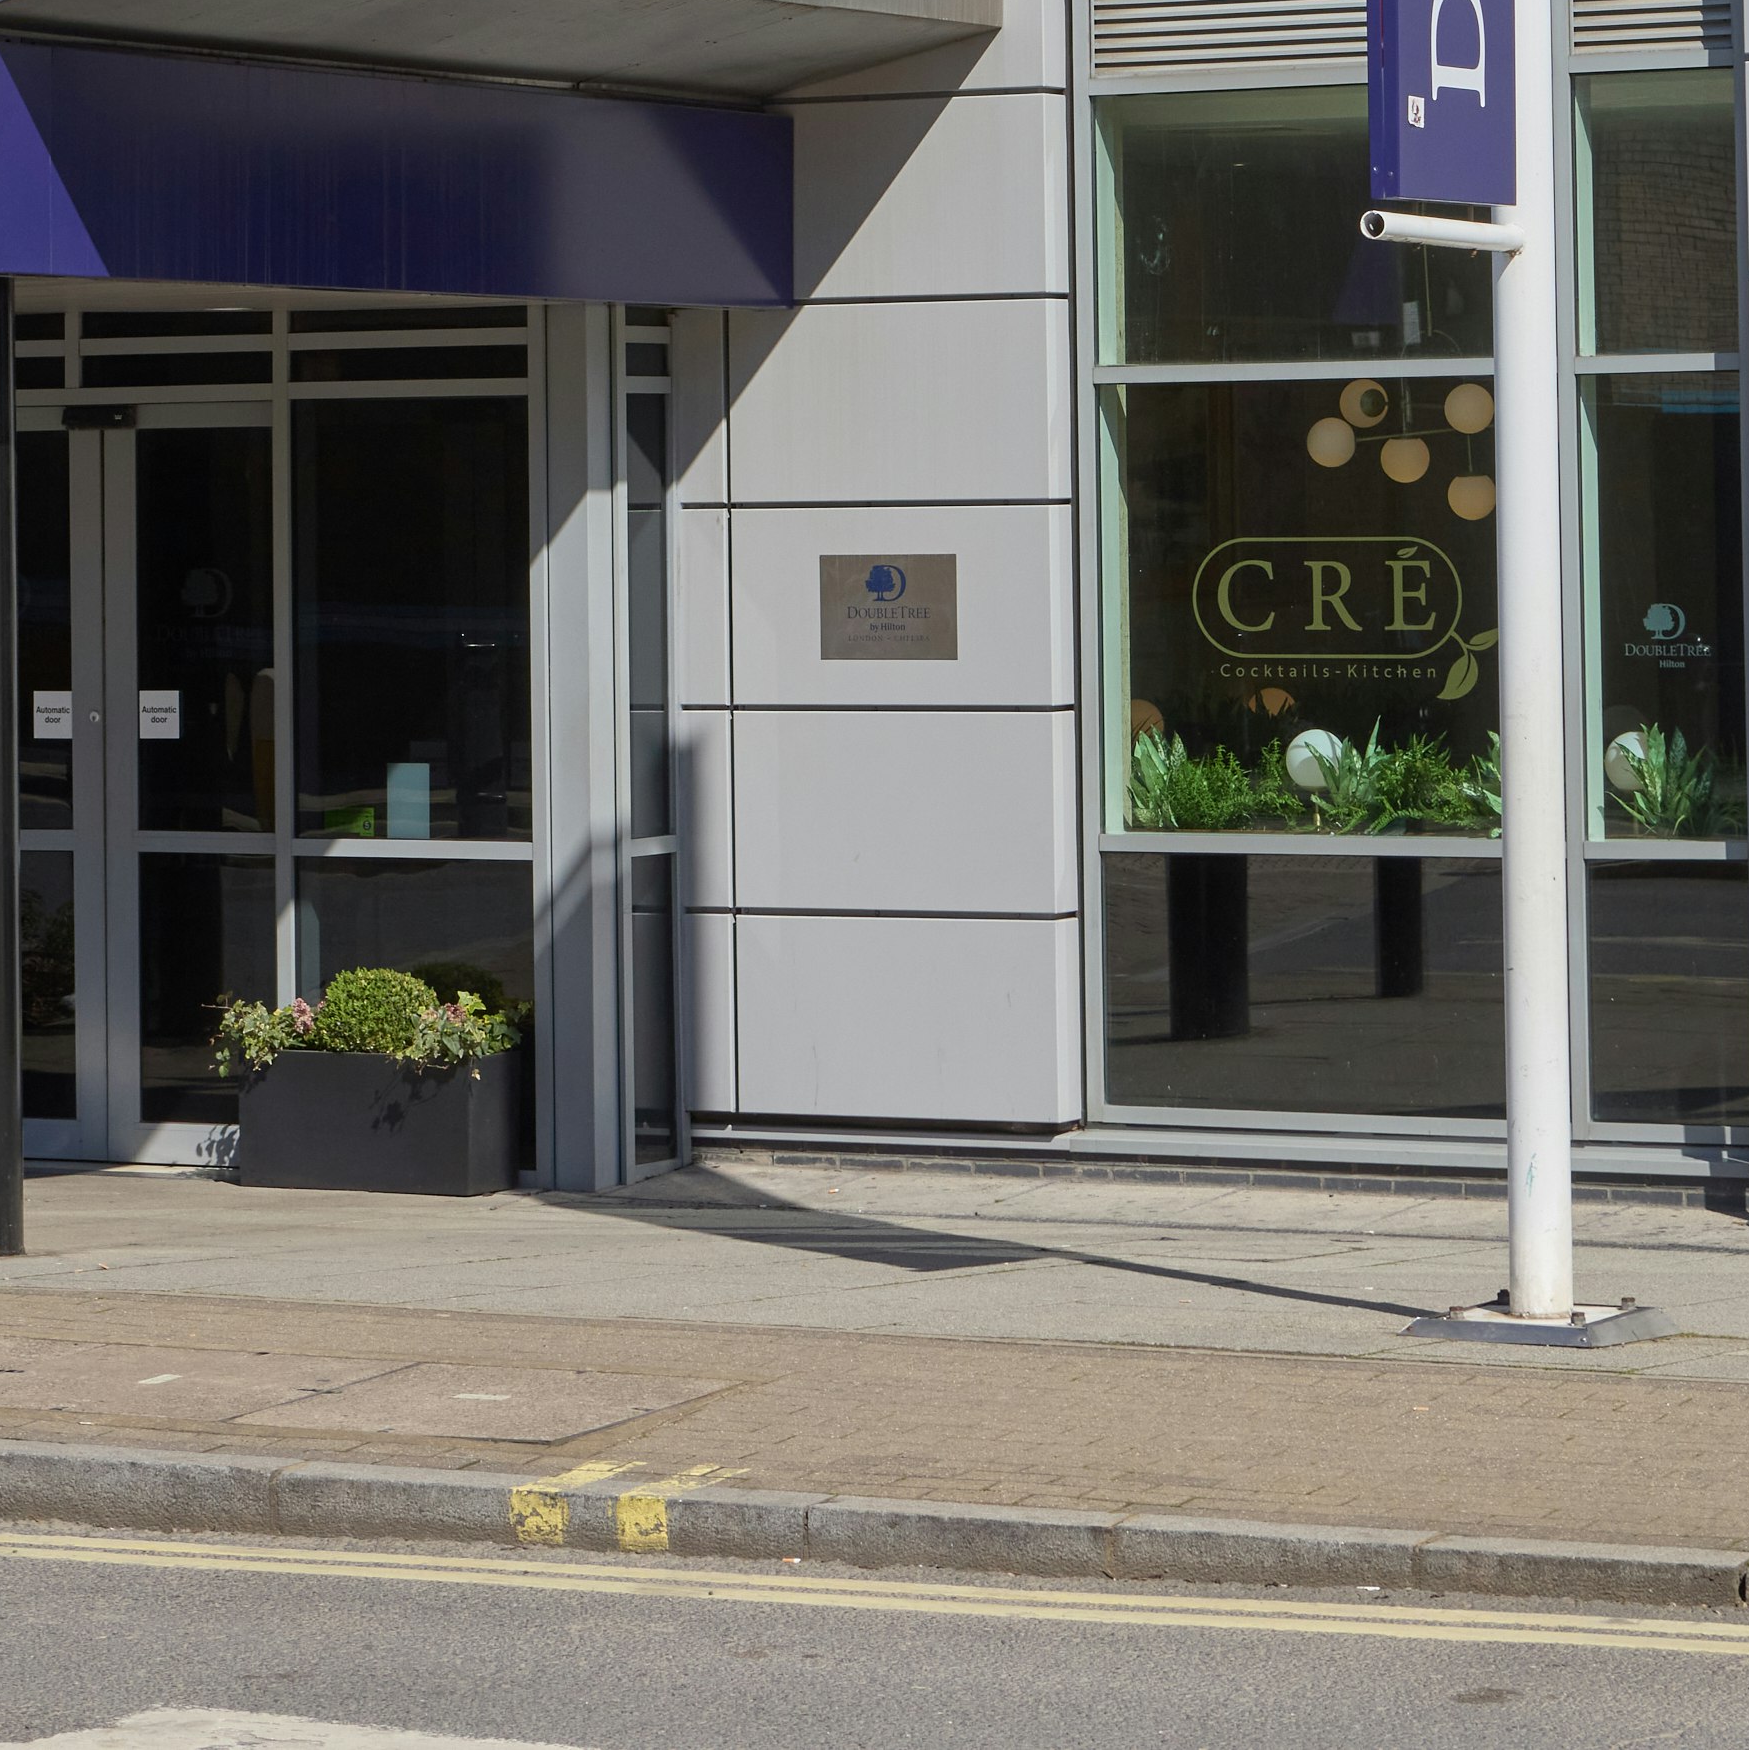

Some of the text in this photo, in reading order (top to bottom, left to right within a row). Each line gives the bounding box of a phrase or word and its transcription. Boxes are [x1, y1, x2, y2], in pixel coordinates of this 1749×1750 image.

[869, 622, 906, 633] by Hilton
[1659, 660, 1686, 668] Hilton
[36, 706, 71, 714] Automatic
[141, 705, 177, 714] Automatic
[44, 716, 61, 724] door
[150, 715, 168, 724] door
